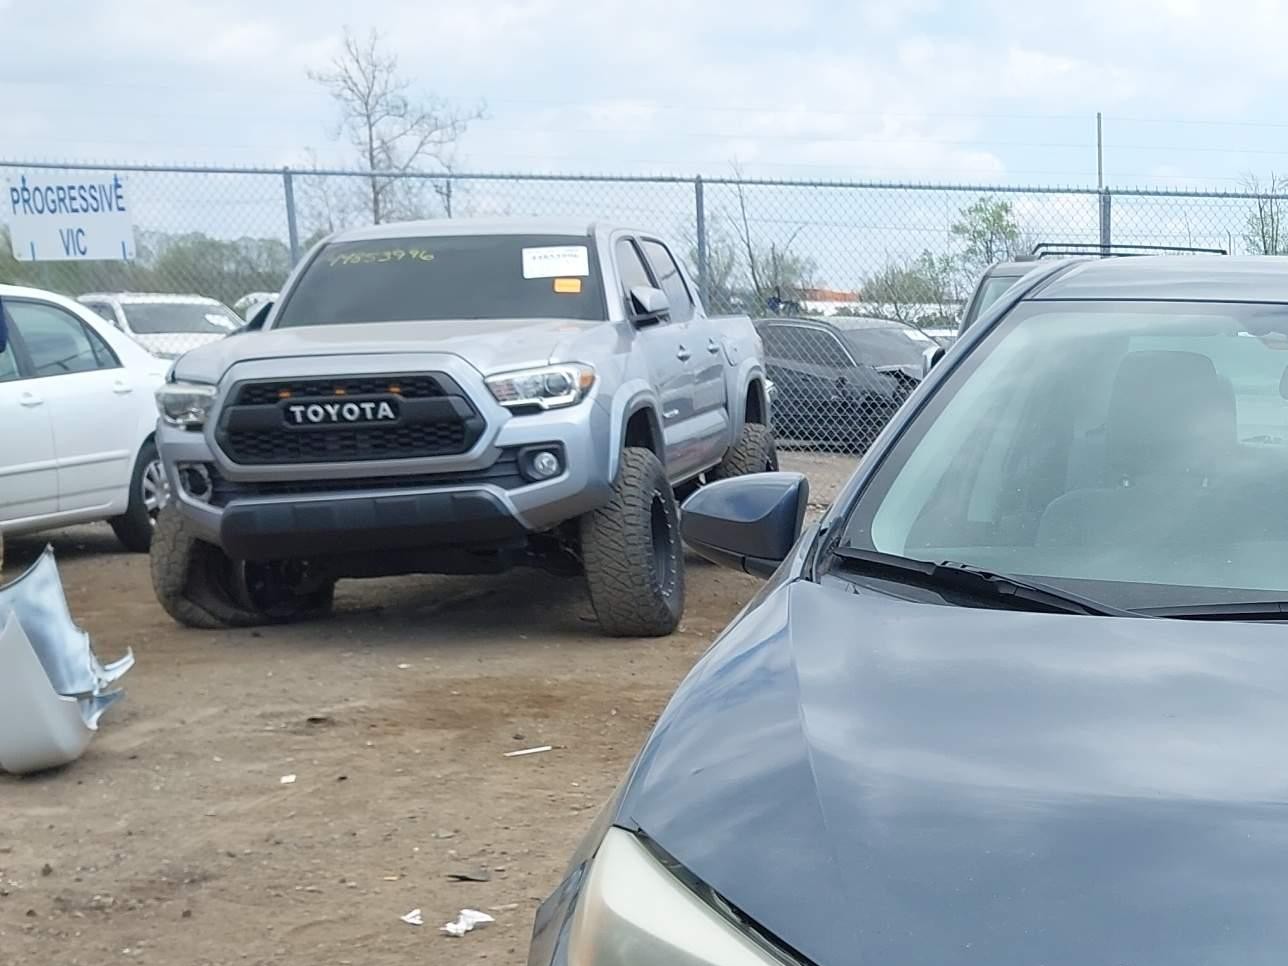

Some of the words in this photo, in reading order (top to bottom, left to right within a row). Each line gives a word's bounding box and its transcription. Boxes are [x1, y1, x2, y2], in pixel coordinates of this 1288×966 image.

[10, 184, 126, 215] PROGRESSIVE
[59, 228, 87, 256] VIC
[289, 401, 395, 423] TOYOTA
